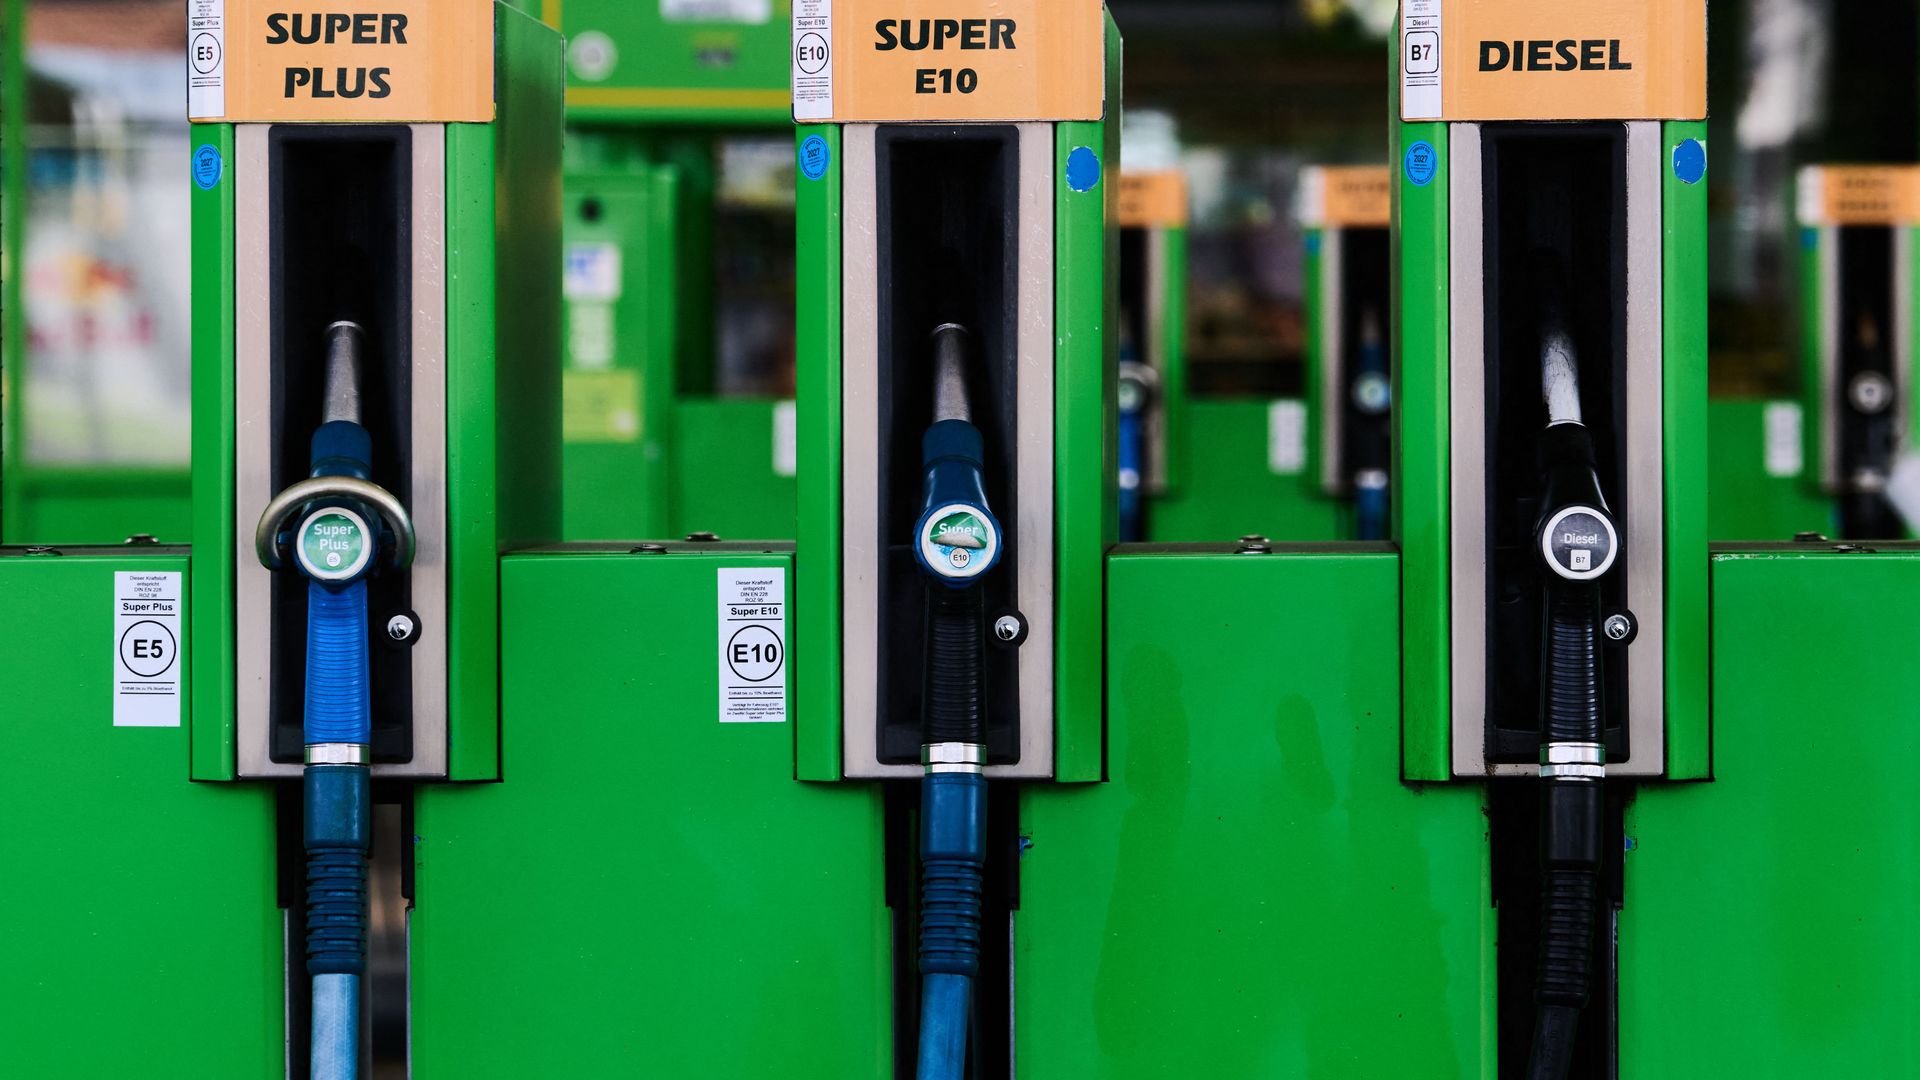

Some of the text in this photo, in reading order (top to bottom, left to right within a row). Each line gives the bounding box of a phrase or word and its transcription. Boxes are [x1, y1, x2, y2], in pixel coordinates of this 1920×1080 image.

[266, 13, 408, 44] SUPER
[875, 18, 1016, 50] SUPER
[197, 46, 213, 60] E5
[799, 46, 825, 60] E10
[1411, 44, 1432, 61] B7
[1478, 39, 1632, 71] DIESEL
[284, 67, 391, 98] PLUS
[915, 68, 978, 94] E10
[1413, 154, 1428, 163] 2027
[313, 523, 354, 538] Super
[319, 538, 349, 551] Plus
[1564, 533, 1598, 545] Diesel
[1575, 556, 1586, 564] B7
[123, 602, 173, 612] Super Plus
[730, 607, 778, 617] Super E10
[133, 639, 163, 659] E5
[733, 643, 777, 663] E10
